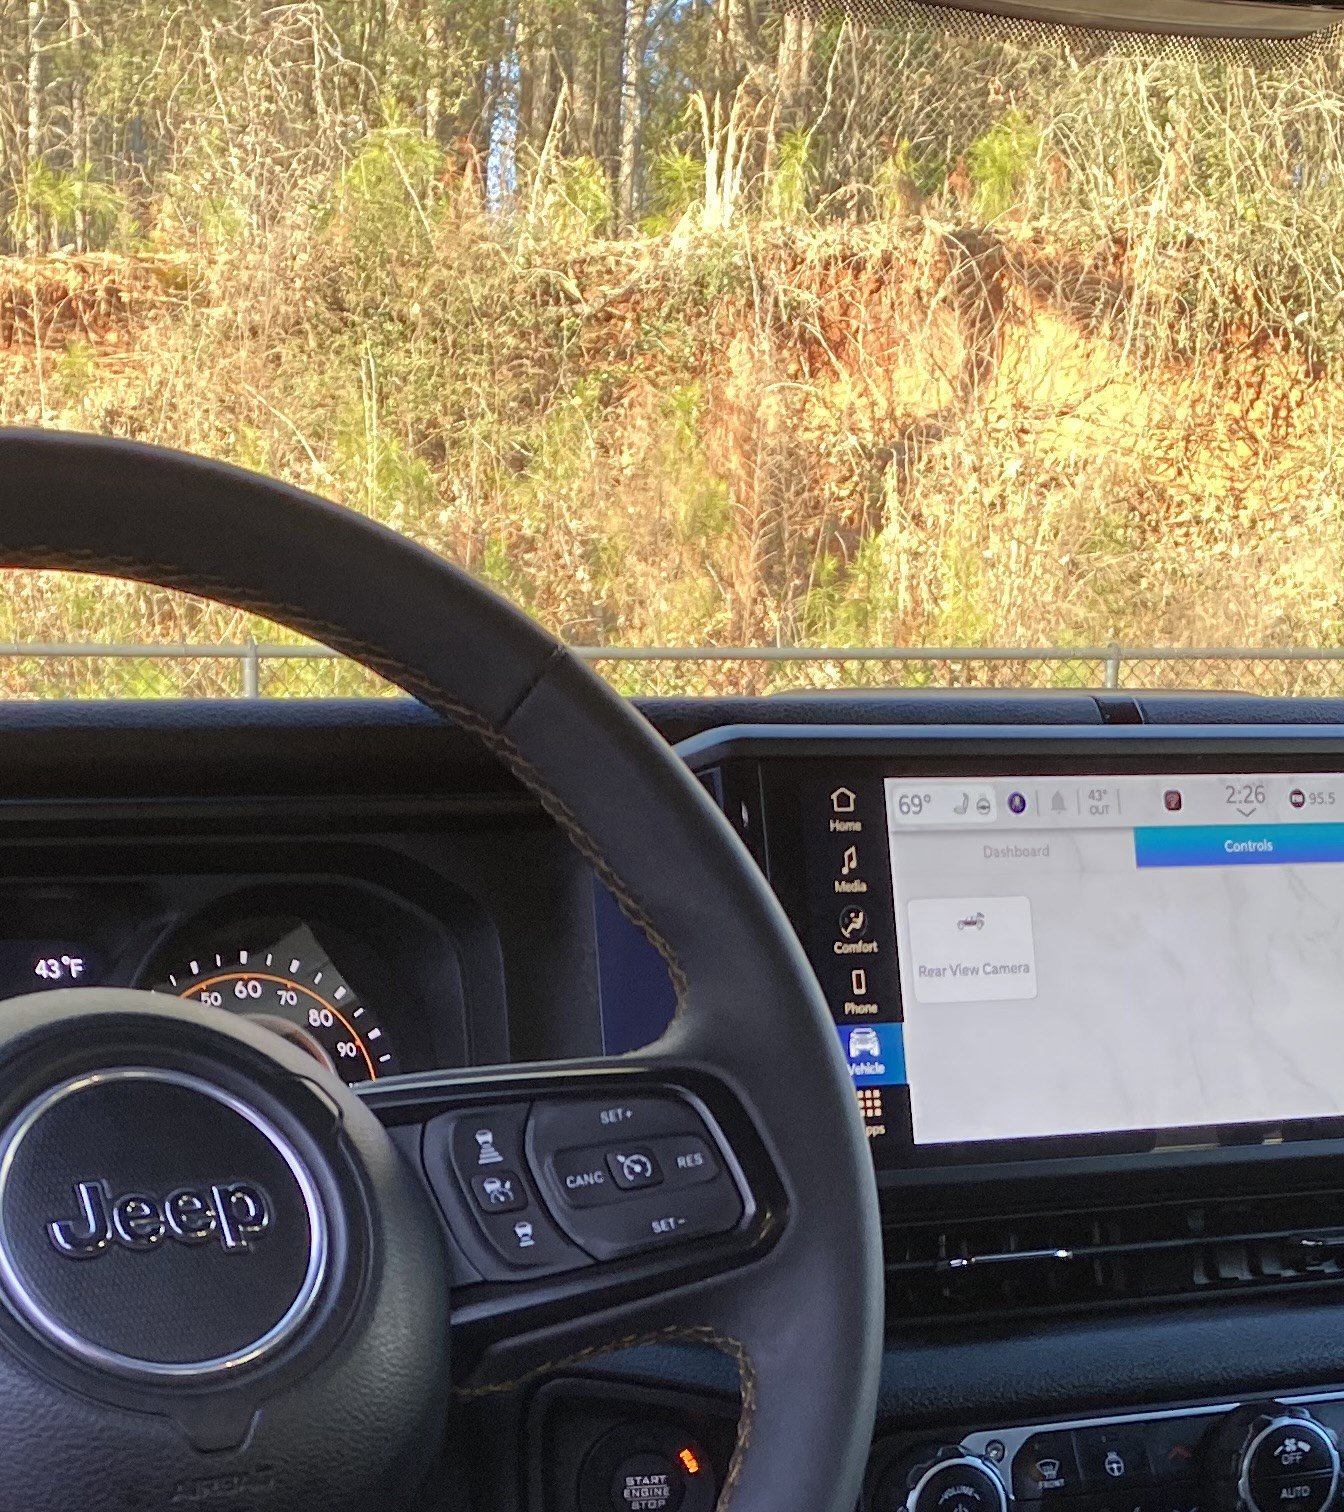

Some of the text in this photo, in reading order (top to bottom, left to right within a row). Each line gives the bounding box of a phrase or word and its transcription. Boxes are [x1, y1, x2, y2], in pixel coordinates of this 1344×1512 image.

[1225, 785, 1266, 805] 2:26
[1308, 791, 1336, 806] 95.5
[1089, 804, 1110, 815] OUT
[829, 818, 862, 833] Home
[983, 844, 1050, 859] Dashboard
[1224, 839, 1273, 854] Controls
[834, 880, 867, 893] Media
[834, 940, 879, 955] Comfort
[919, 961, 1030, 979] Rear View Camera
[234, 980, 262, 999] 60
[200, 991, 222, 1008] 50
[276, 990, 298, 1006] 70
[845, 1002, 878, 1016] Phone
[308, 1008, 334, 1027] 80
[336, 1041, 357, 1058] 90
[847, 1062, 885, 1076] Vehicle
[865, 1124, 886, 1138] pps
[677, 1152, 703, 1169] RES
[566, 1171, 604, 1189] CANC
[47, 1179, 274, 1260] Jeep
[626, 1475, 666, 1486] START
[624, 1486, 671, 1498] ENGINE
[1280, 1485, 1310, 1500] AUTO
[631, 1499, 666, 1510] STOP
